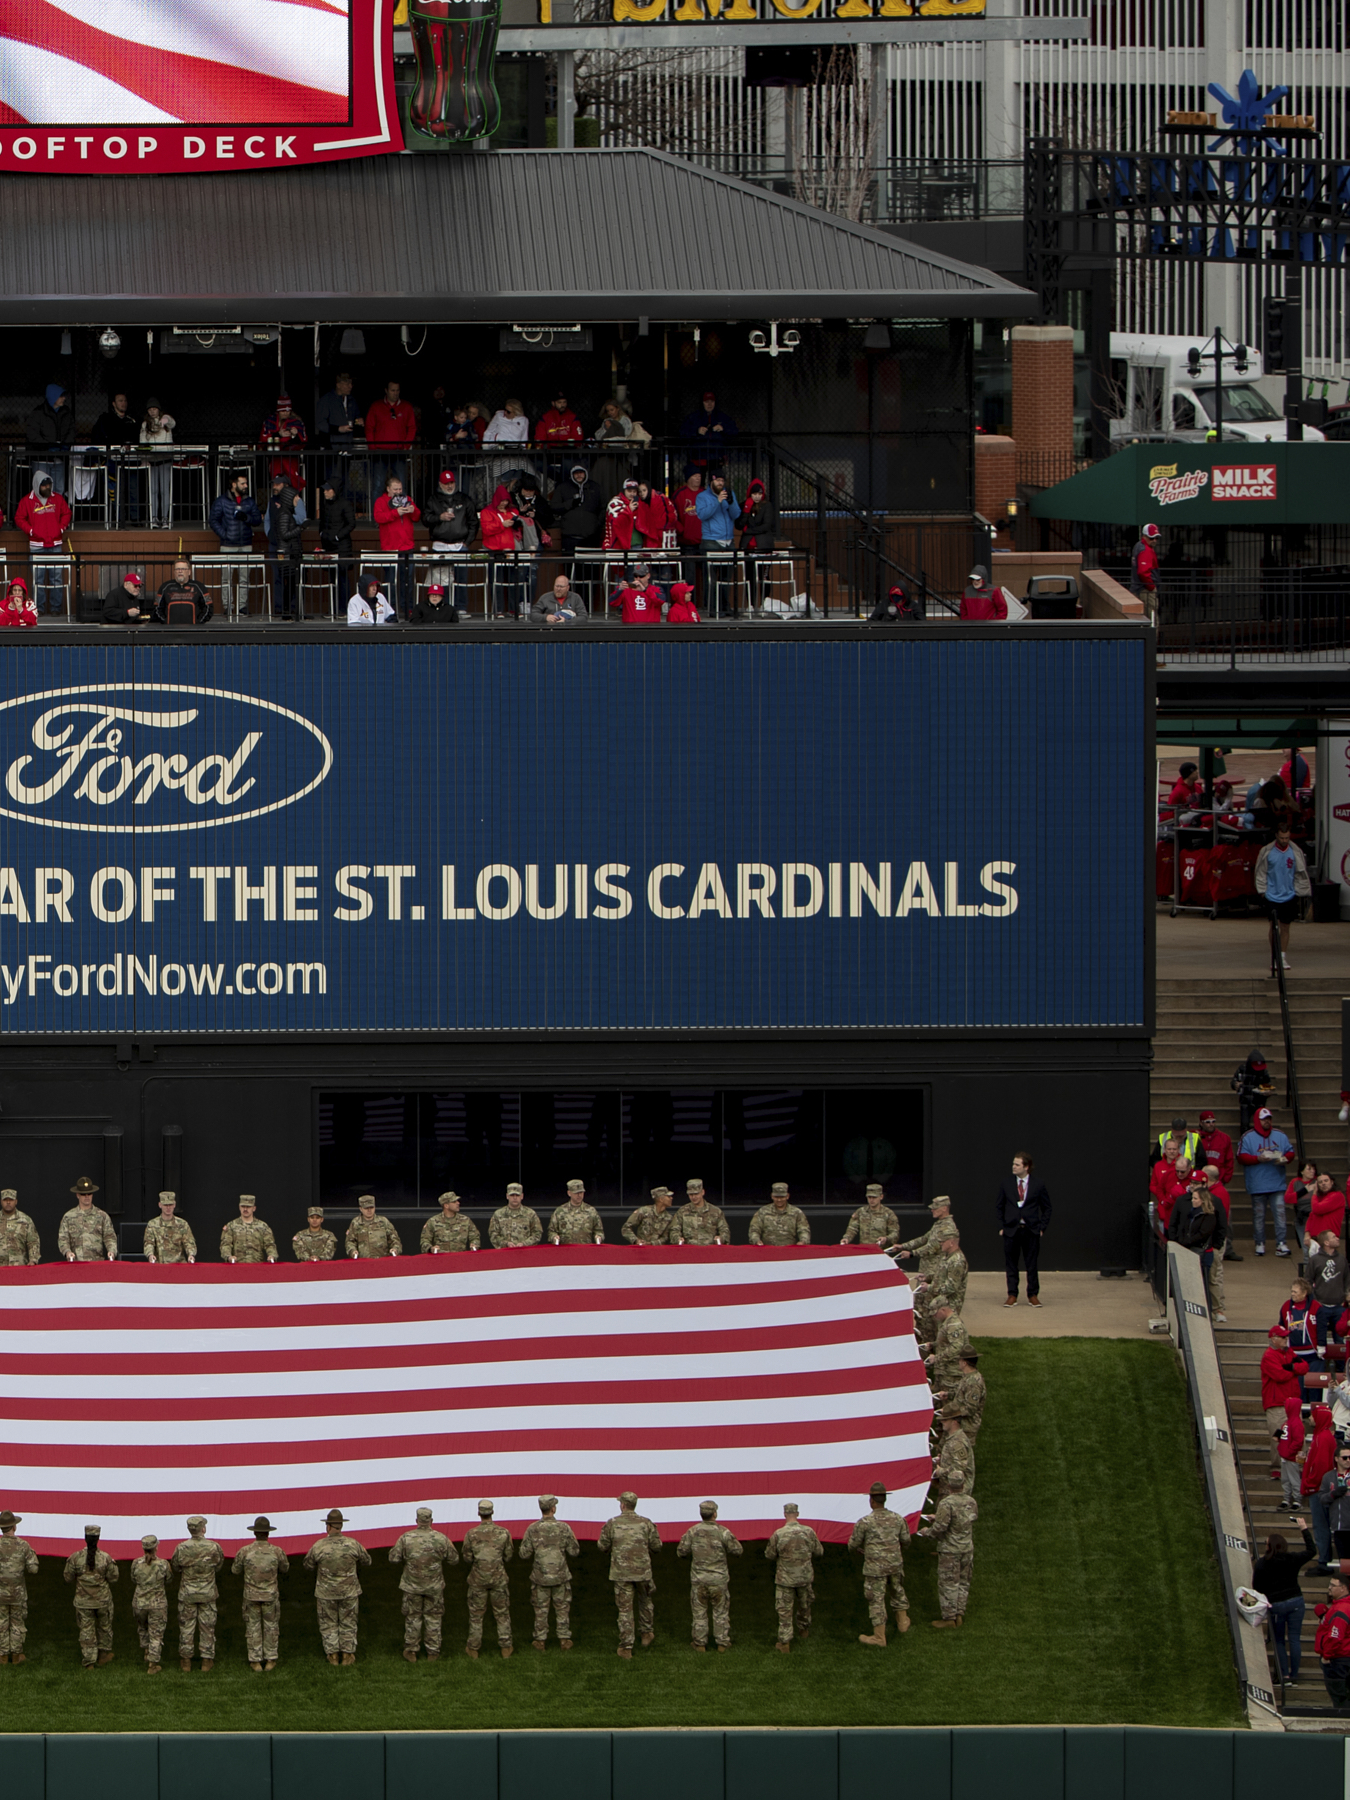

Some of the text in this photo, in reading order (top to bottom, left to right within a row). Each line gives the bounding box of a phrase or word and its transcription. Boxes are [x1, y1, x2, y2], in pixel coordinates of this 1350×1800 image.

[182, 135, 299, 160] DECK
[1148, 469, 1208, 498] Prairie
[1213, 468, 1275, 485] MILK
[1158, 485, 1200, 505] Farms
[1212, 486, 1275, 498] SNACK
[5, 703, 264, 806] Ford
[90, 866, 176, 923] OF
[189, 865, 319, 922] THE
[333, 864, 425, 921] ST.
[442, 863, 633, 920] LOUIS
[647, 860, 1019, 919] CARDINALS
